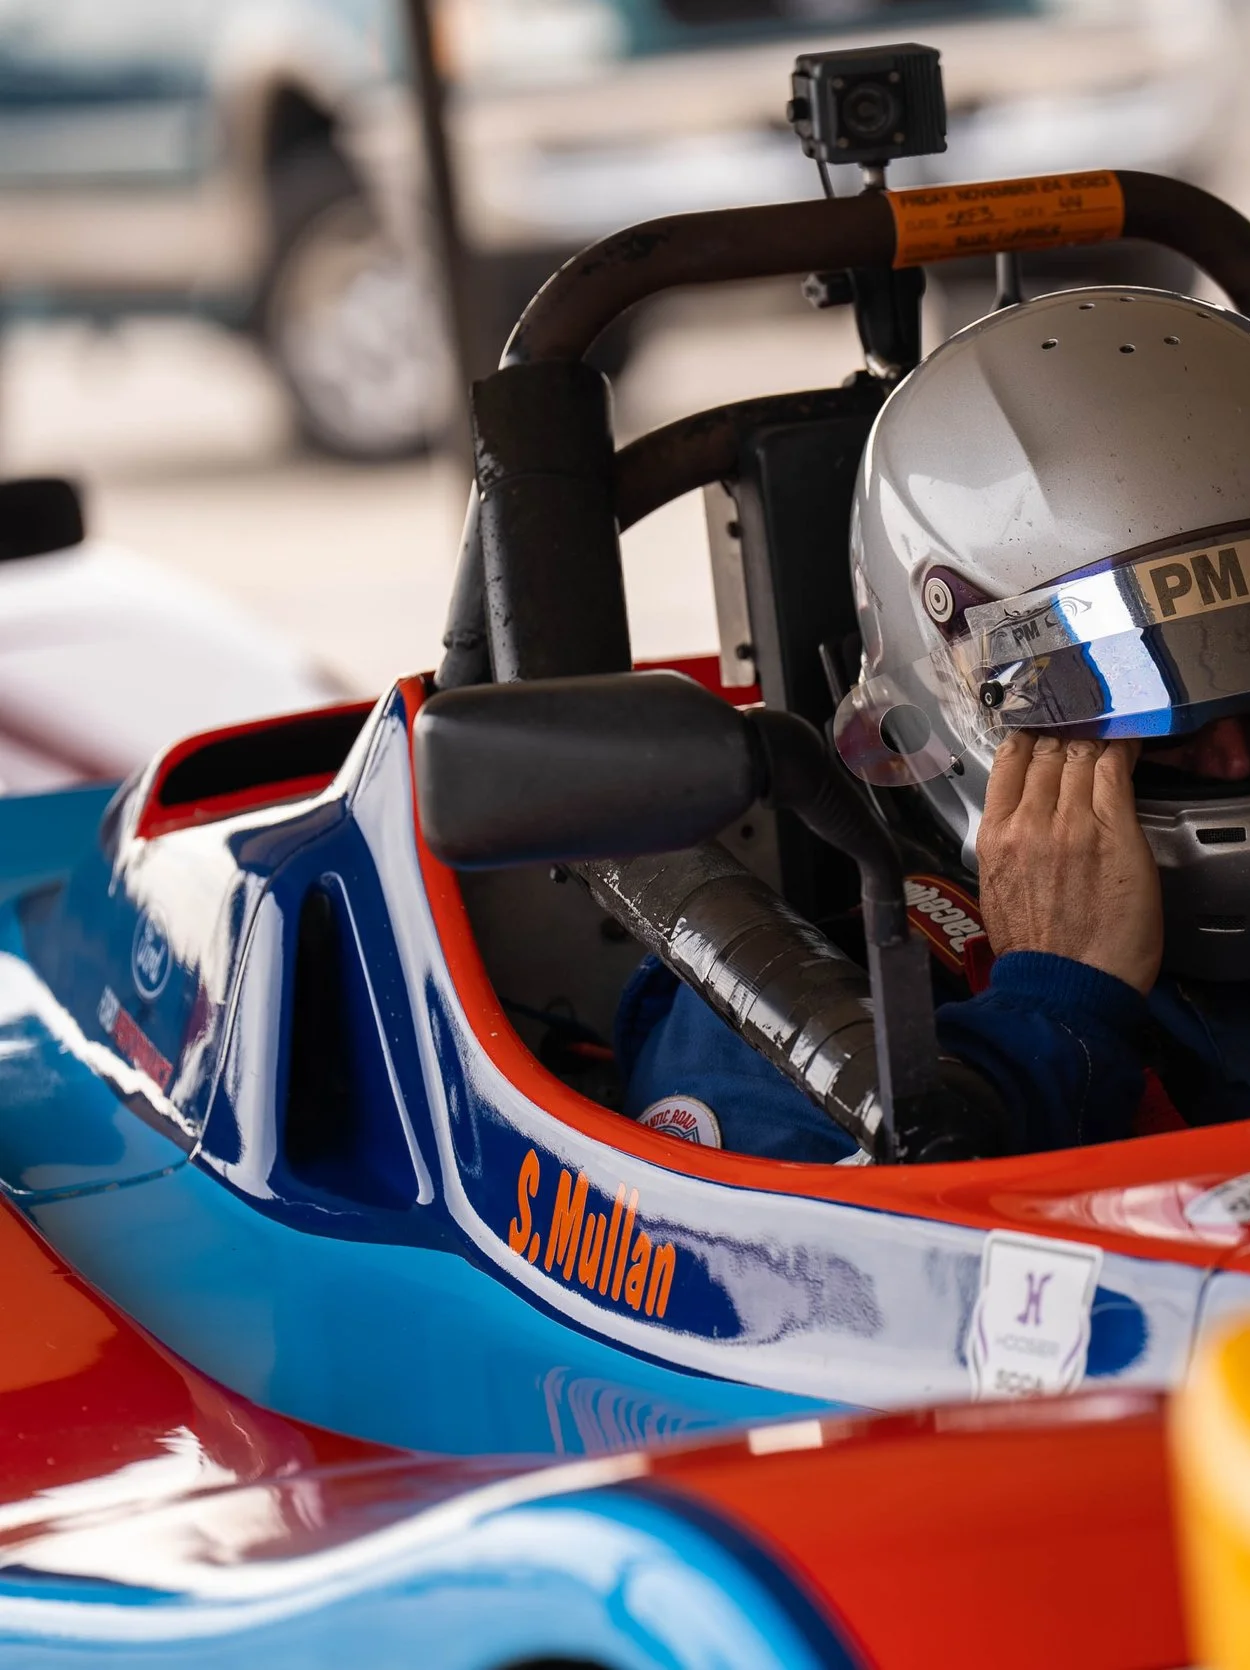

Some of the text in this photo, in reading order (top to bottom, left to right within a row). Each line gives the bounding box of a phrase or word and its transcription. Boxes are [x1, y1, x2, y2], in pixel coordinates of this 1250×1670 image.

[1149, 547, 1250, 618] PM
[1012, 620, 1040, 646] PM
[670, 1109, 697, 1130] ROAD
